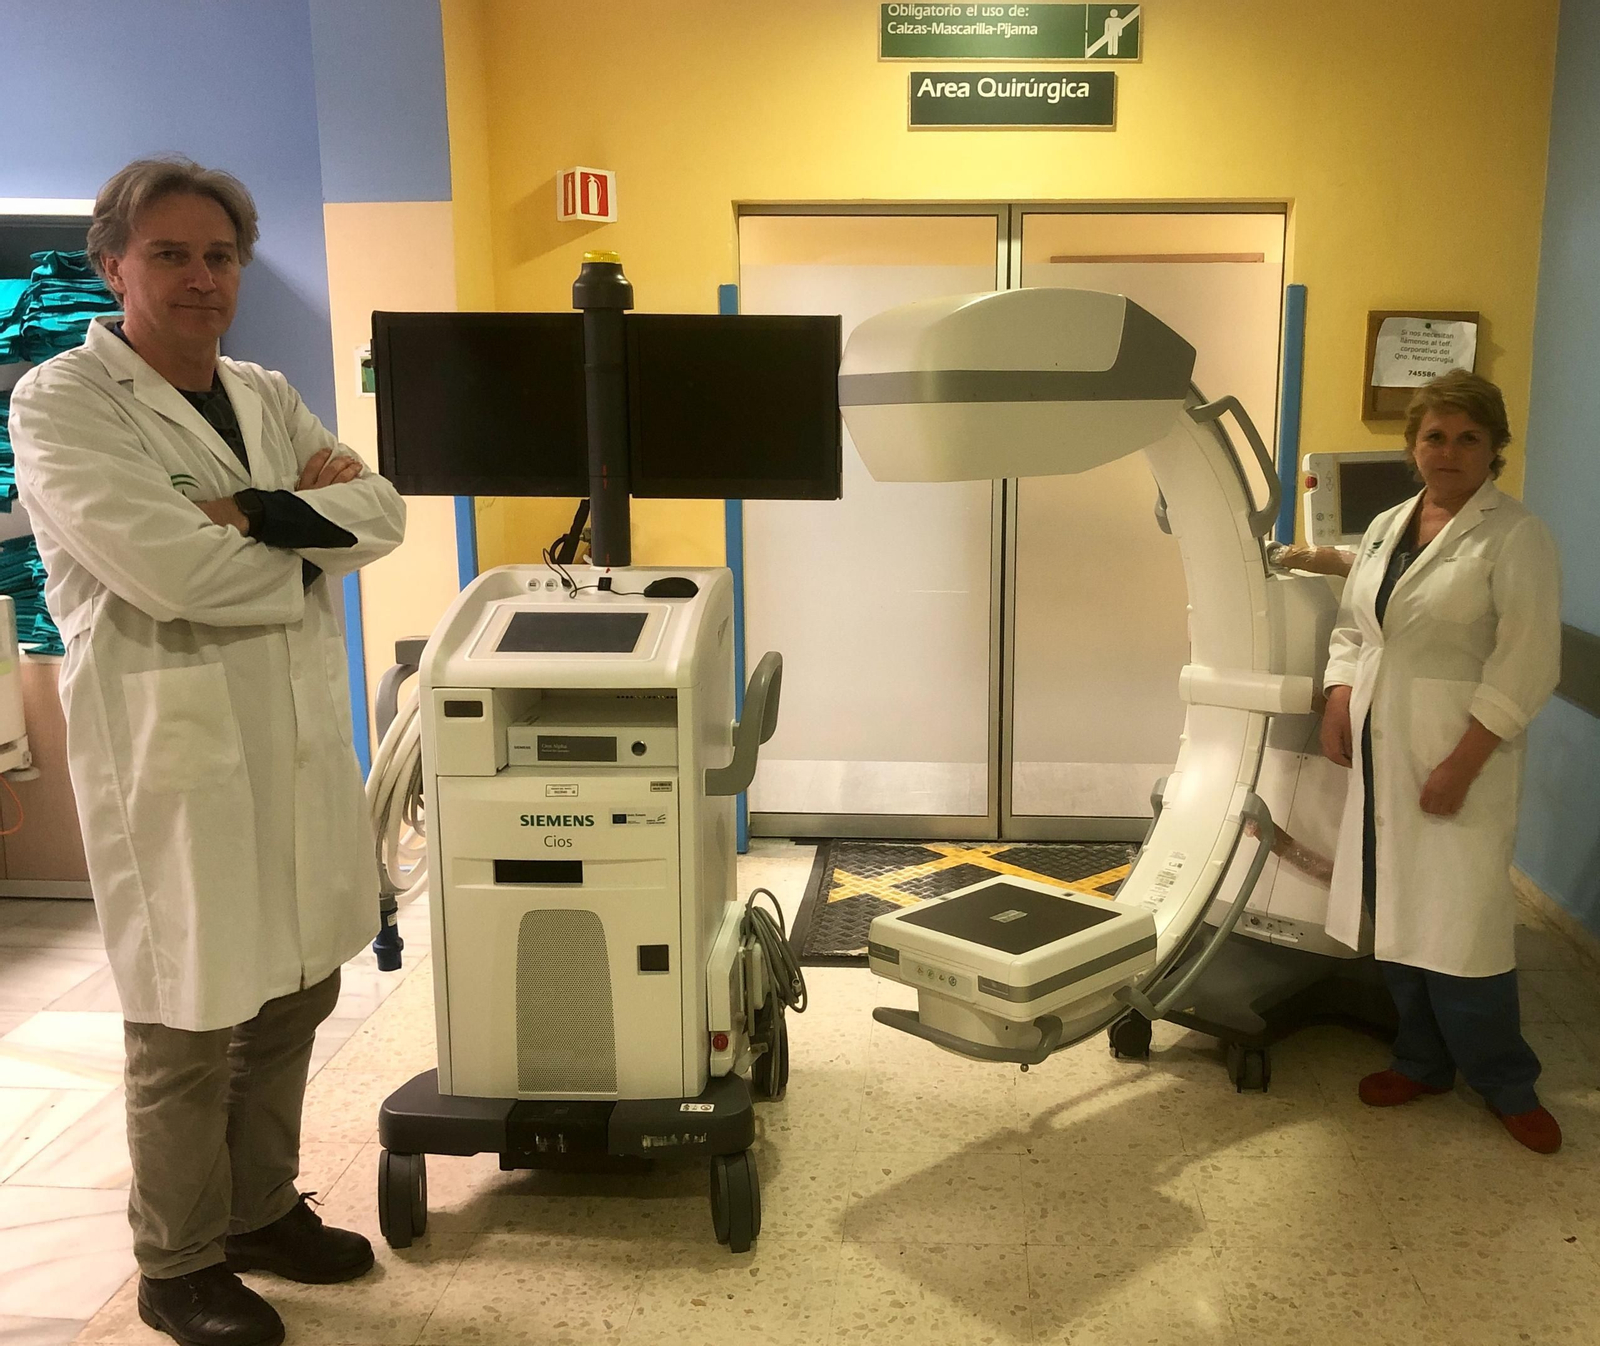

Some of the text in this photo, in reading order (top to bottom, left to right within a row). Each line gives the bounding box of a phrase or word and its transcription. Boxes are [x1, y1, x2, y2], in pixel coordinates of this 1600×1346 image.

[887, 4, 1029, 19] Obligatorio el uso de:
[887, 22, 1038, 38] Calzas-Mascarilla-Pijama
[917, 78, 1090, 103] Area Quirúrgica
[1408, 370, 1436, 378] 745586
[520, 815, 595, 827] SIEMENS
[543, 835, 573, 848] Cios
